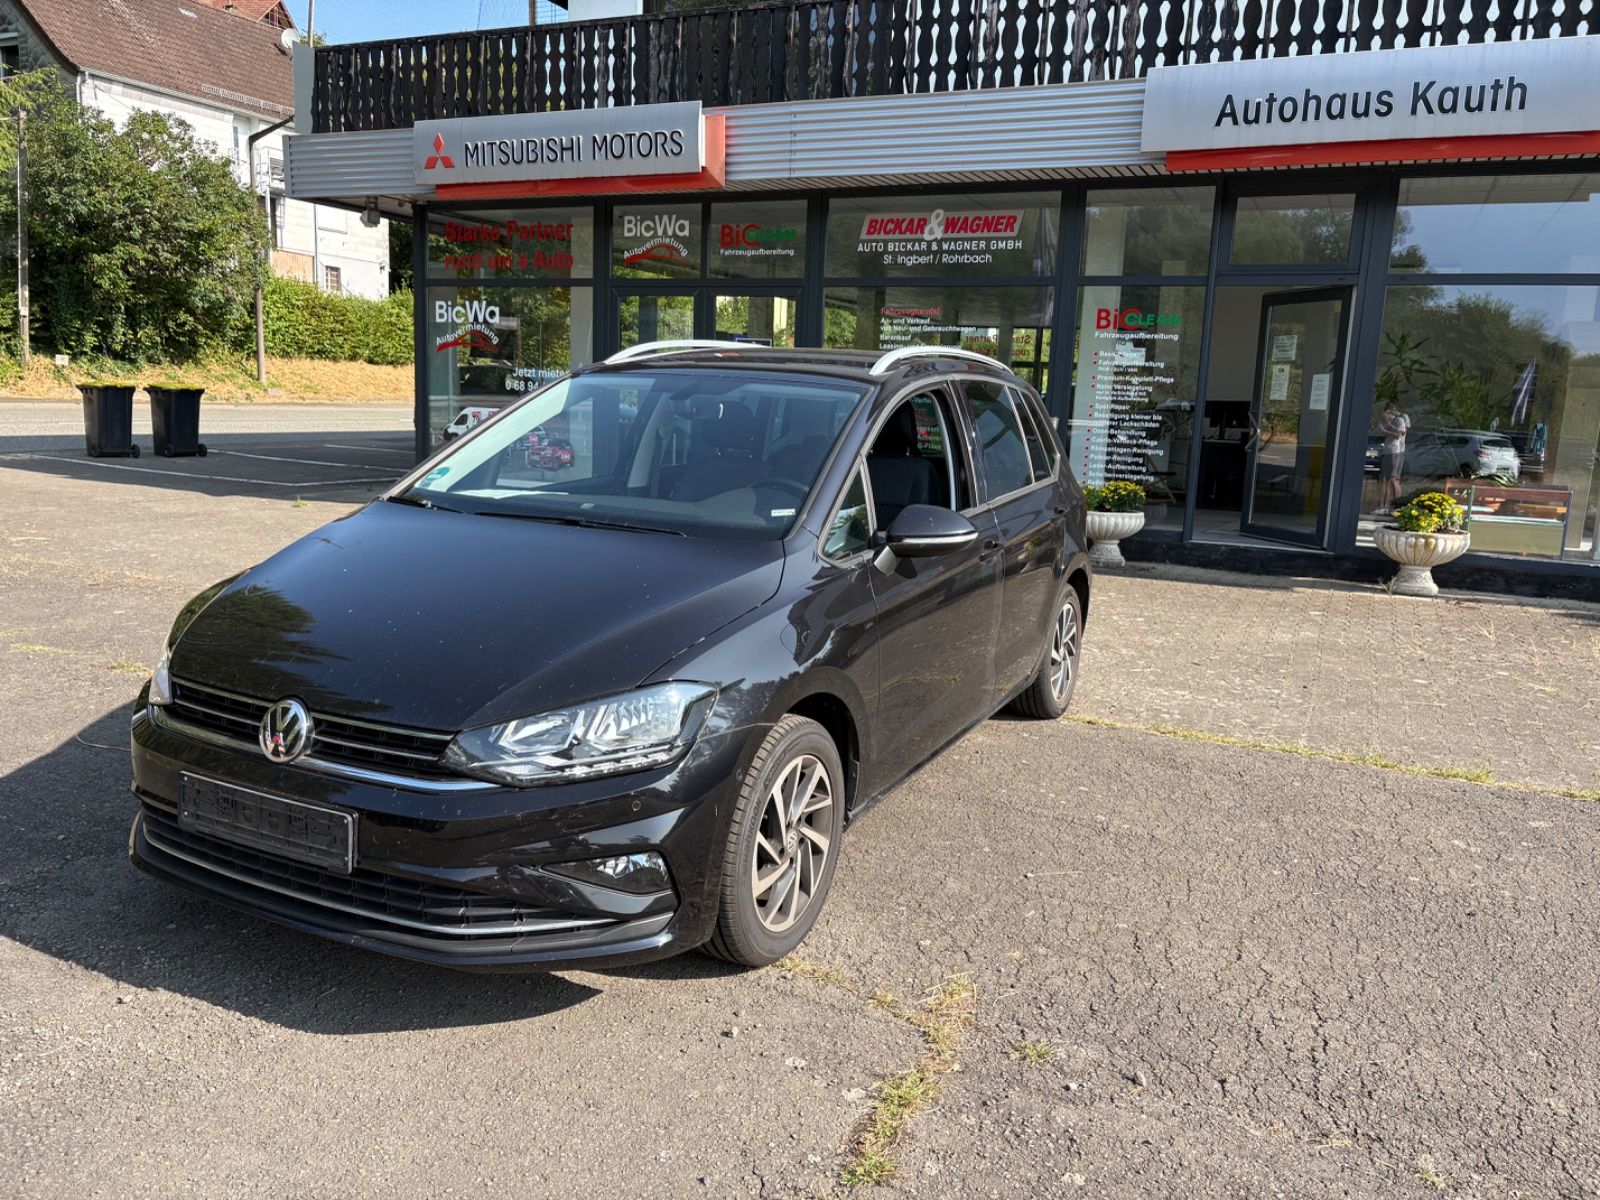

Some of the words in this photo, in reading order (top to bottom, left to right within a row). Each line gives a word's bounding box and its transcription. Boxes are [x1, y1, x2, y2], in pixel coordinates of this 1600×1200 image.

[1214, 88, 1394, 127] Autohaus
[1409, 75, 1529, 116] Kauth
[464, 135, 584, 168] MITSUBISHI
[592, 129, 685, 163] MOTORS
[445, 220, 501, 242] Starke
[506, 219, 575, 241] Partner
[623, 214, 690, 237] BicWa
[866, 216, 928, 236] BICKAR
[923, 208, 945, 241] &
[943, 214, 1018, 234] WAGNER
[623, 235, 689, 259] Autovermietung
[720, 248, 795, 257] Fahrzeugaufbereitung
[857, 242, 884, 252] AUTO
[888, 241, 928, 252] BICKAR
[931, 241, 939, 251] &
[942, 240, 986, 251] WAGNER
[990, 240, 1023, 250] GMBH
[444, 252, 482, 270] rund
[533, 248, 575, 271] Auto
[883, 254, 894, 264] St.
[897, 254, 933, 266] Ingbert
[942, 253, 993, 264] Rohrbach
[435, 300, 500, 324] BicWa
[436, 322, 500, 346] Autovermietung
[923, 325, 977, 333] Gebrauchtwagen
[1094, 332, 1179, 340] Fahrzeugaufbereitung
[512, 367, 536, 377] Jetzt
[506, 381, 512, 391] 0
[514, 381, 526, 391] 68
[259, 699, 309, 763] VW
